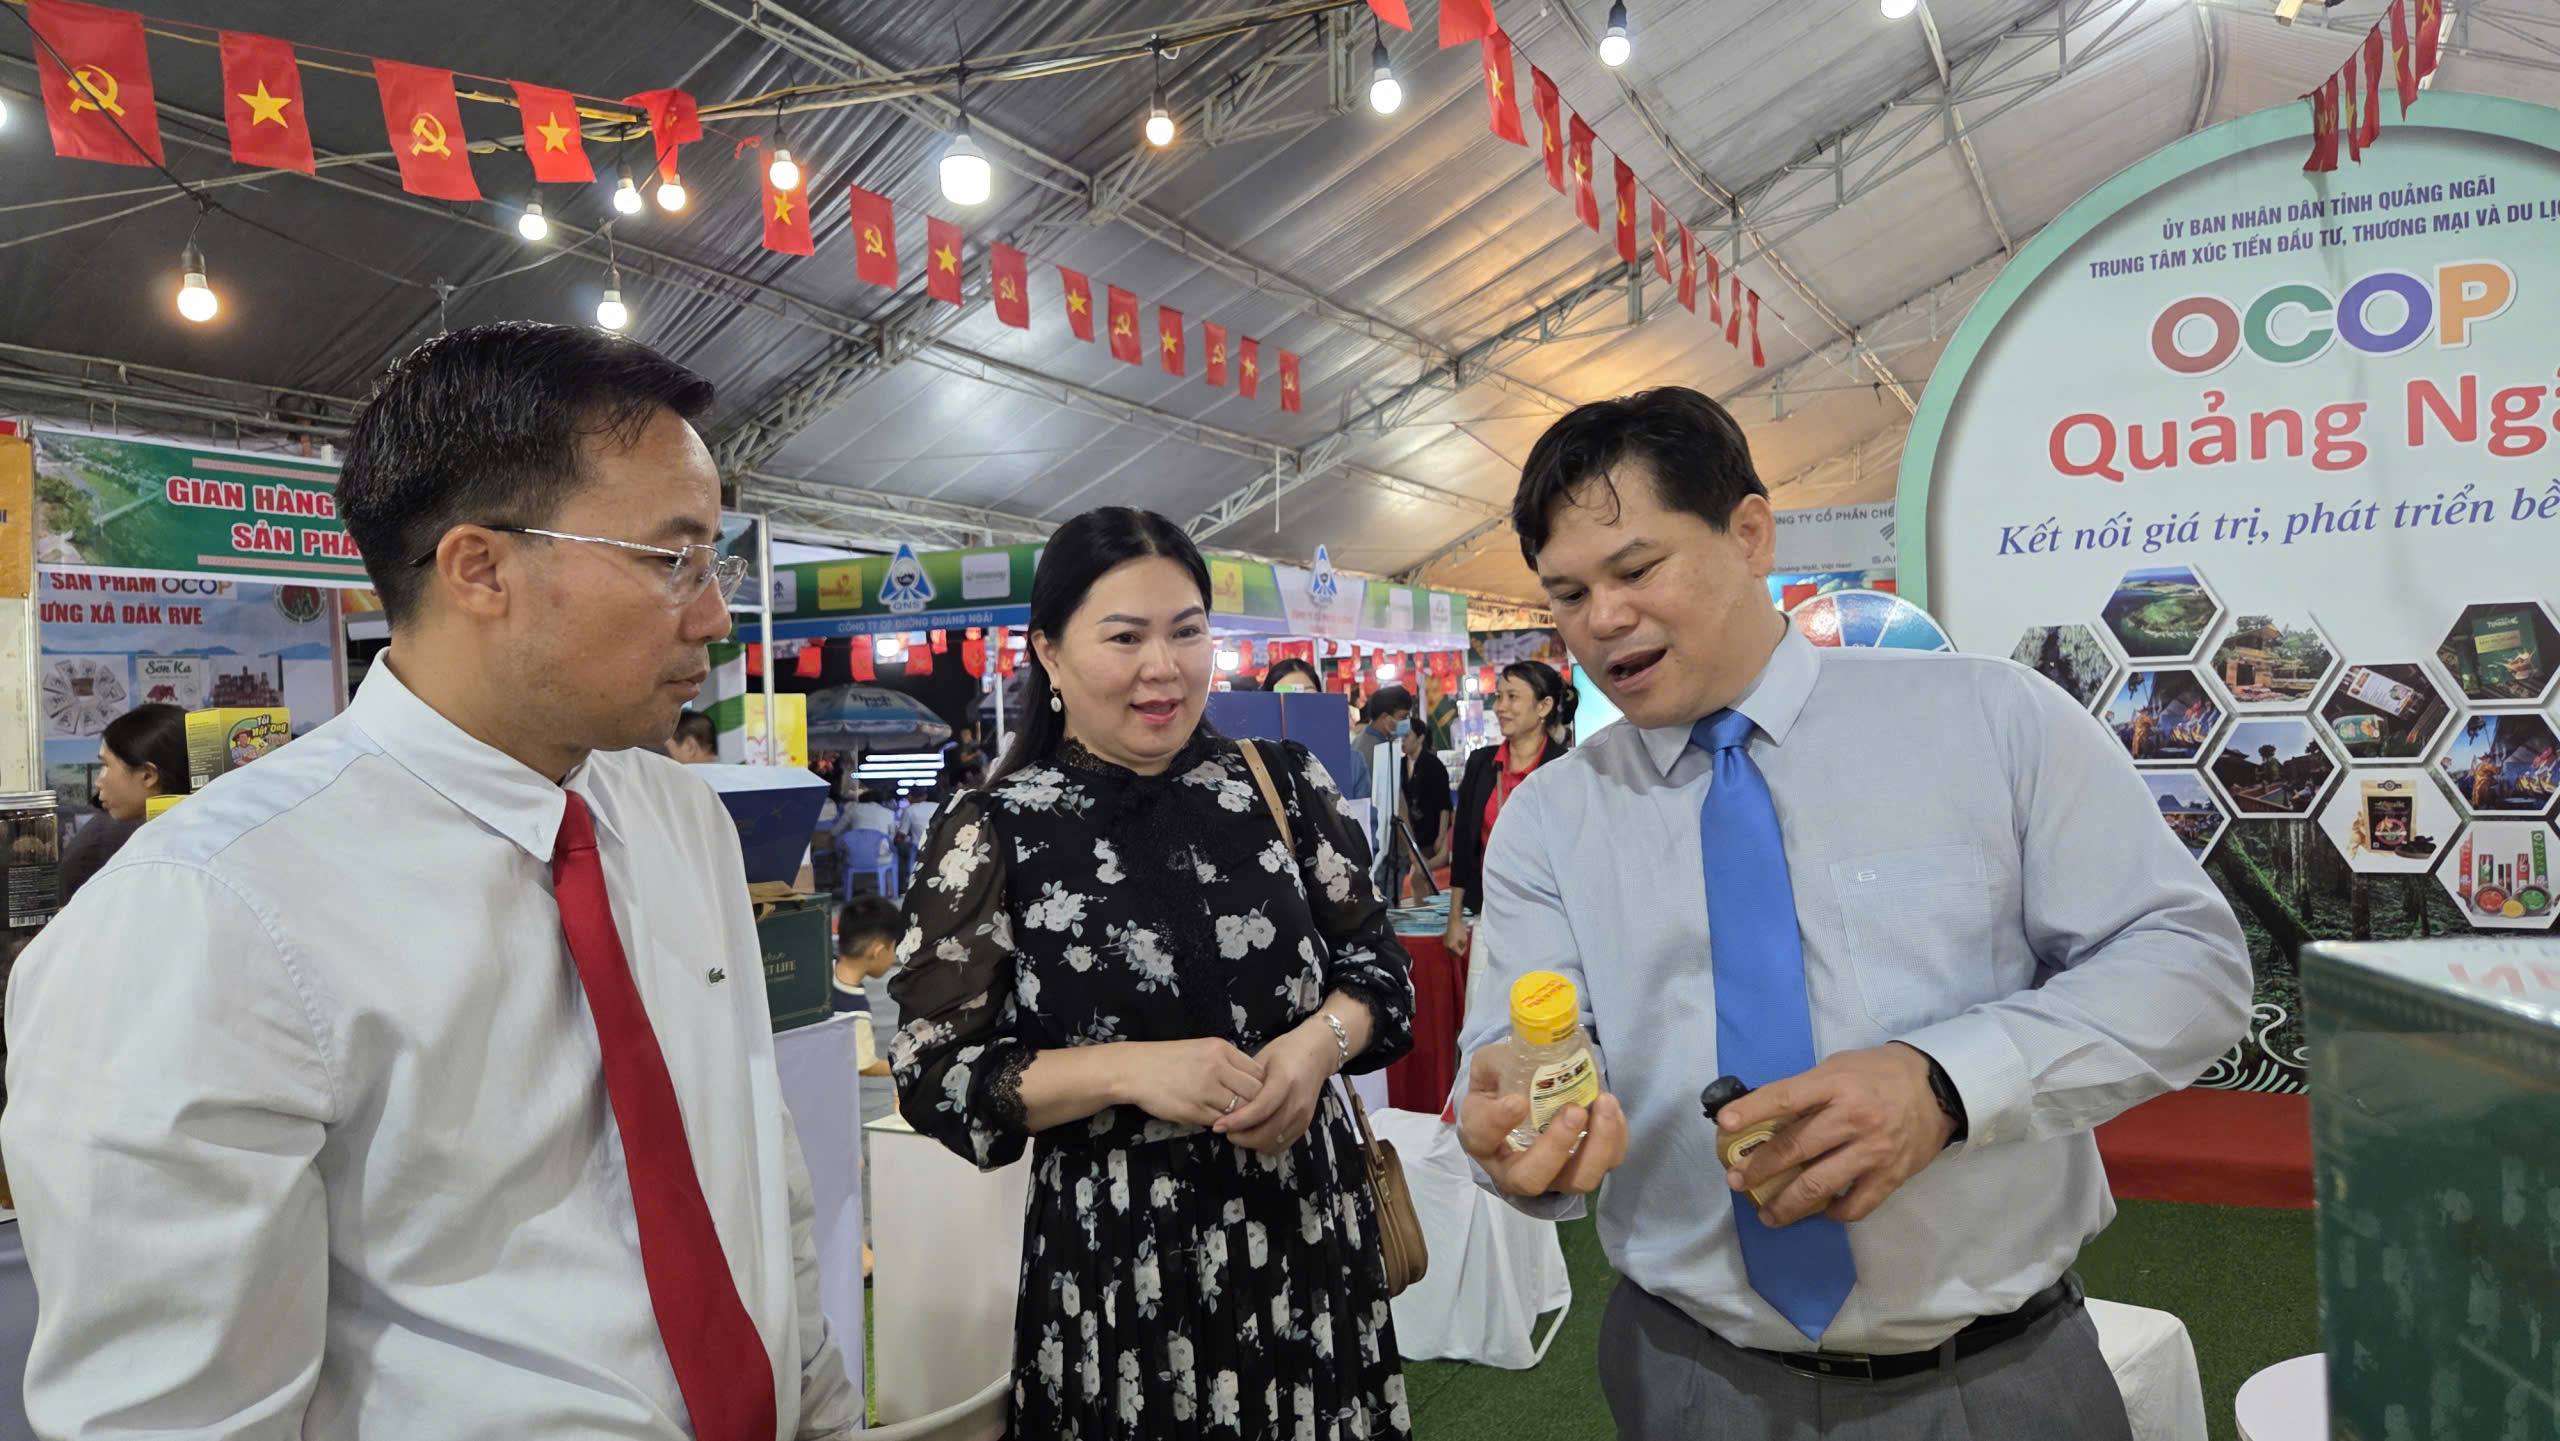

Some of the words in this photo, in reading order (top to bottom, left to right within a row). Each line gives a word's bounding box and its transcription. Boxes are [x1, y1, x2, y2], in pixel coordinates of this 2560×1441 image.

[2089, 255, 2145, 279] TRUNG
[2149, 249, 2187, 272] TÂM
[2191, 242, 2227, 265] XÚC
[2231, 233, 2272, 259] TIẾN
[2352, 218, 2427, 243] THƯƠNG
[2433, 210, 2470, 235] MẠI
[2475, 203, 2501, 227] VÀ
[2507, 202, 2533, 223] DU
[2539, 199, 2560, 222] LỊ
[2162, 217, 2184, 241] ỦY
[2190, 215, 2226, 237] BAN
[2231, 205, 2282, 231] NHÂN
[2287, 199, 2325, 223] DÂN
[2330, 192, 2373, 216] TỈNH
[2378, 182, 2444, 211] QUẢNG
[2449, 174, 2496, 201] NGÃI
[2150, 260, 2514, 376] OCOP
[2047, 390, 2369, 483] Quảng
[167, 476, 245, 511] GIAN
[253, 484, 337, 519] HÀNG
[1797, 514, 1812, 524] TY
[1996, 515, 2063, 556] Kết
[2073, 511, 2134, 551] nối
[2142, 511, 2201, 554] giá
[2213, 507, 2271, 546] trị,
[2280, 499, 2382, 545] phát
[2392, 483, 2495, 529] triển
[2510, 478, 2560, 522] bề
[232, 520, 294, 555] SẢN
[168, 606, 203, 625] RVE
